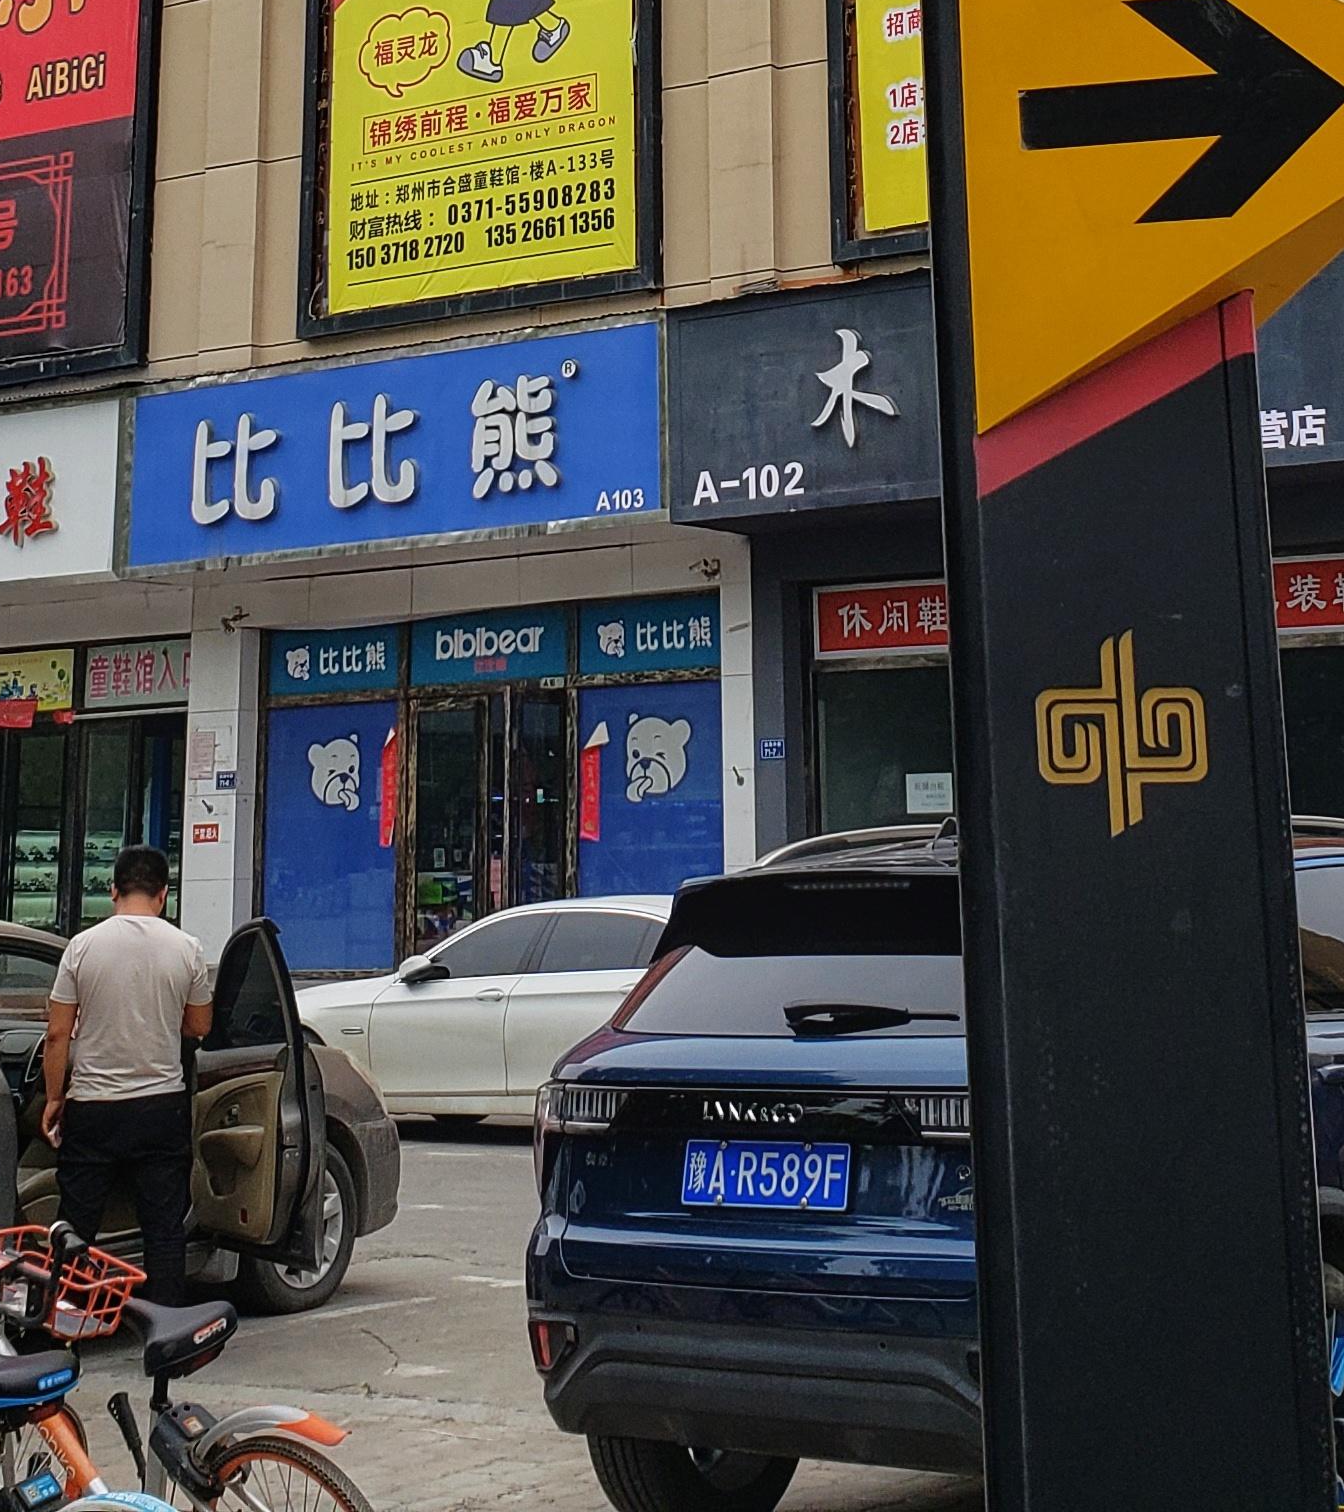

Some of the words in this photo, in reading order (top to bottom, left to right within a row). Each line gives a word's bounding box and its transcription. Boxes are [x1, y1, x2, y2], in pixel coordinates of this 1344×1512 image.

[373, 29, 439, 68] 福灵龙
[26, 52, 107, 102] AiBiCi
[368, 80, 593, 150] 锦绣前程·福爱万家
[350, 157, 378, 173] IT'S
[385, 153, 403, 167] MY
[410, 141, 474, 162] COOLEST
[481, 134, 509, 150] AND
[515, 126, 552, 143] ONLY
[558, 115, 618, 136] DRAGON
[446, 177, 616, 227] 0371-55908283
[346, 243, 377, 271] 150
[380, 236, 421, 265] 3718
[423, 230, 466, 258] 2720
[484, 221, 516, 248] 135
[521, 214, 565, 243] 2661
[569, 206, 616, 236] 1356
[810, 328, 902, 449] 木
[190, 372, 560, 527] 比比熊
[595, 488, 645, 512] A103
[692, 461, 805, 507] A-102
[636, 615, 713, 652] 比比熊
[837, 594, 948, 639] 休闲鞋
[319, 641, 387, 675] 比比熊
